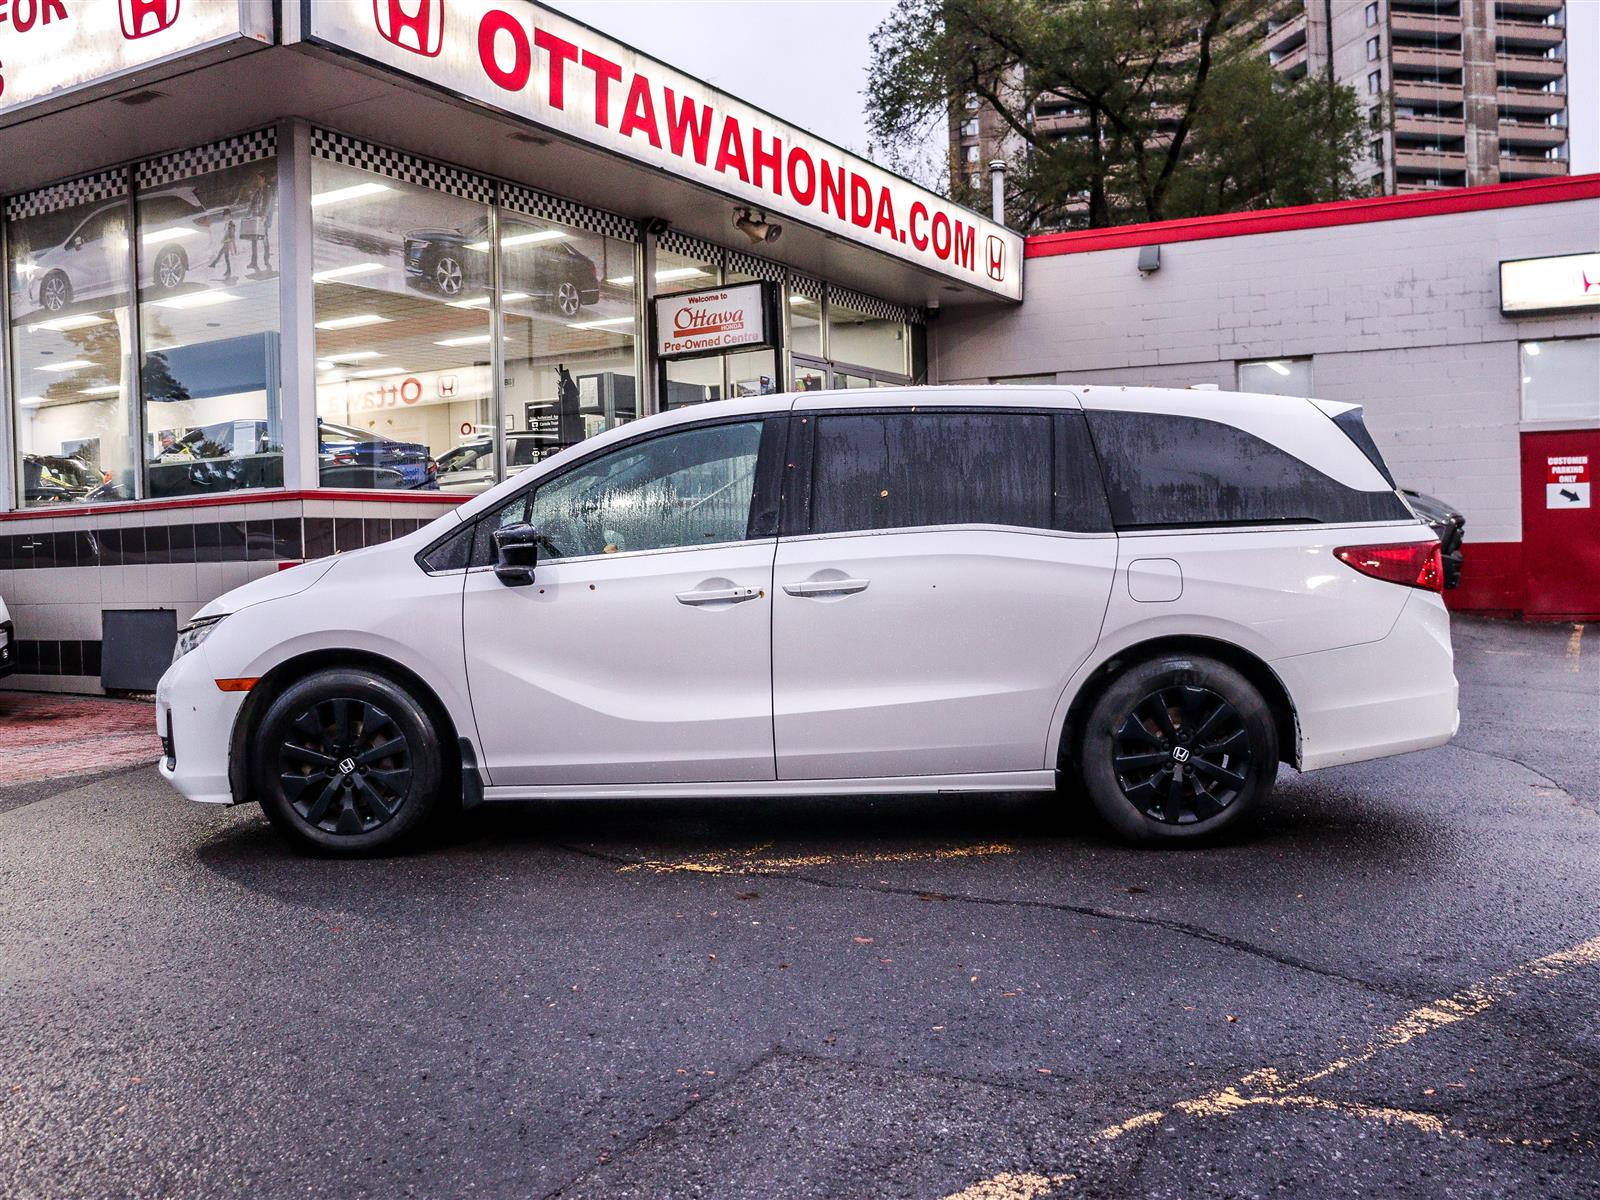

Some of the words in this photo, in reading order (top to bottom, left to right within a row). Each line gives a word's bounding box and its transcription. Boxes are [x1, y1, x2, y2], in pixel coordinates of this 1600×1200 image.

[0, 0, 68, 33] OR
[478, 10, 975, 272] OTTAWAHONDA.COM
[688, 295, 719, 305] Welcome
[720, 292, 728, 301] to
[674, 306, 744, 330] Ottawa
[721, 323, 742, 331] HONDA
[664, 335, 721, 353] Pre-Owned
[723, 331, 759, 345] Centre
[1547, 456, 1588, 465] CUSTOMER
